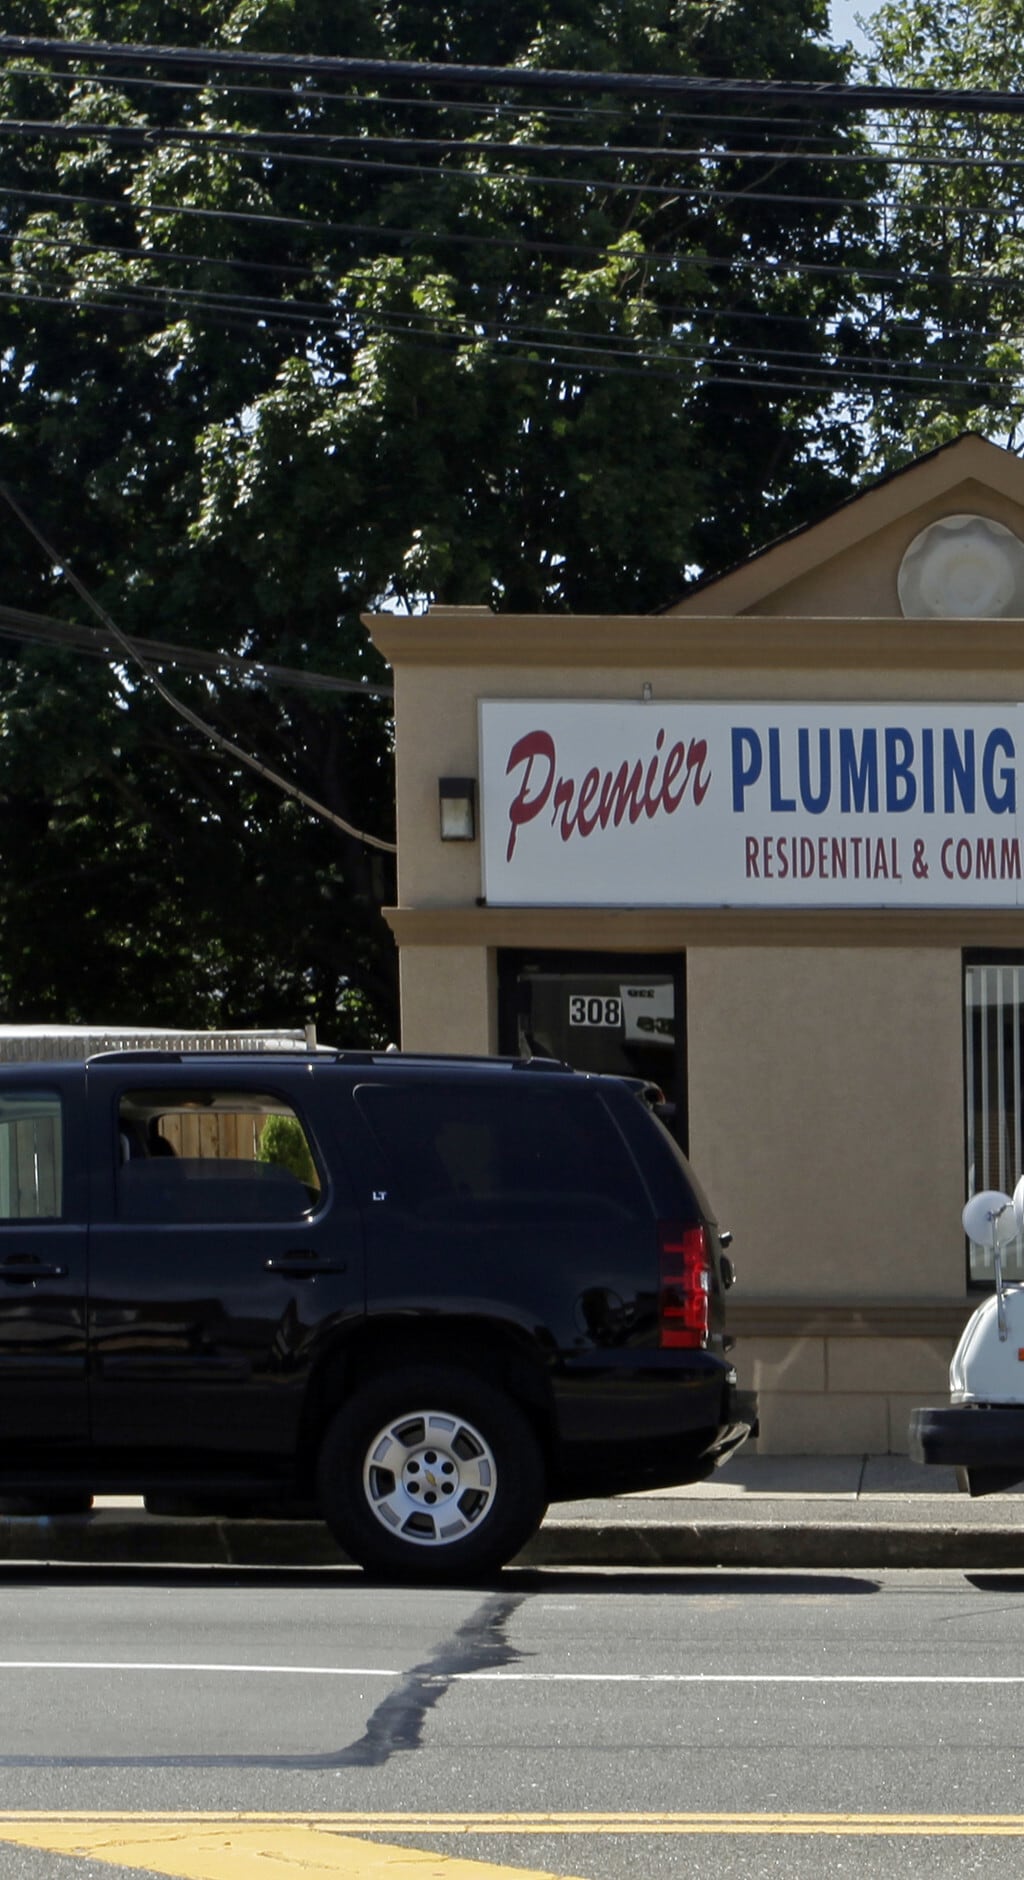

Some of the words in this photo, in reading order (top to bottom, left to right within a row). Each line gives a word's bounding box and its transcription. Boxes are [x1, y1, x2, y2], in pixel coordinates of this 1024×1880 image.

[505, 727, 712, 864] Premier
[730, 726, 1016, 816] PLUMBING
[744, 836, 903, 880] RESIDENTIAL
[911, 837, 930, 880] &
[571, 997, 620, 1025] 308
[372, 1191, 387, 1201] LT
